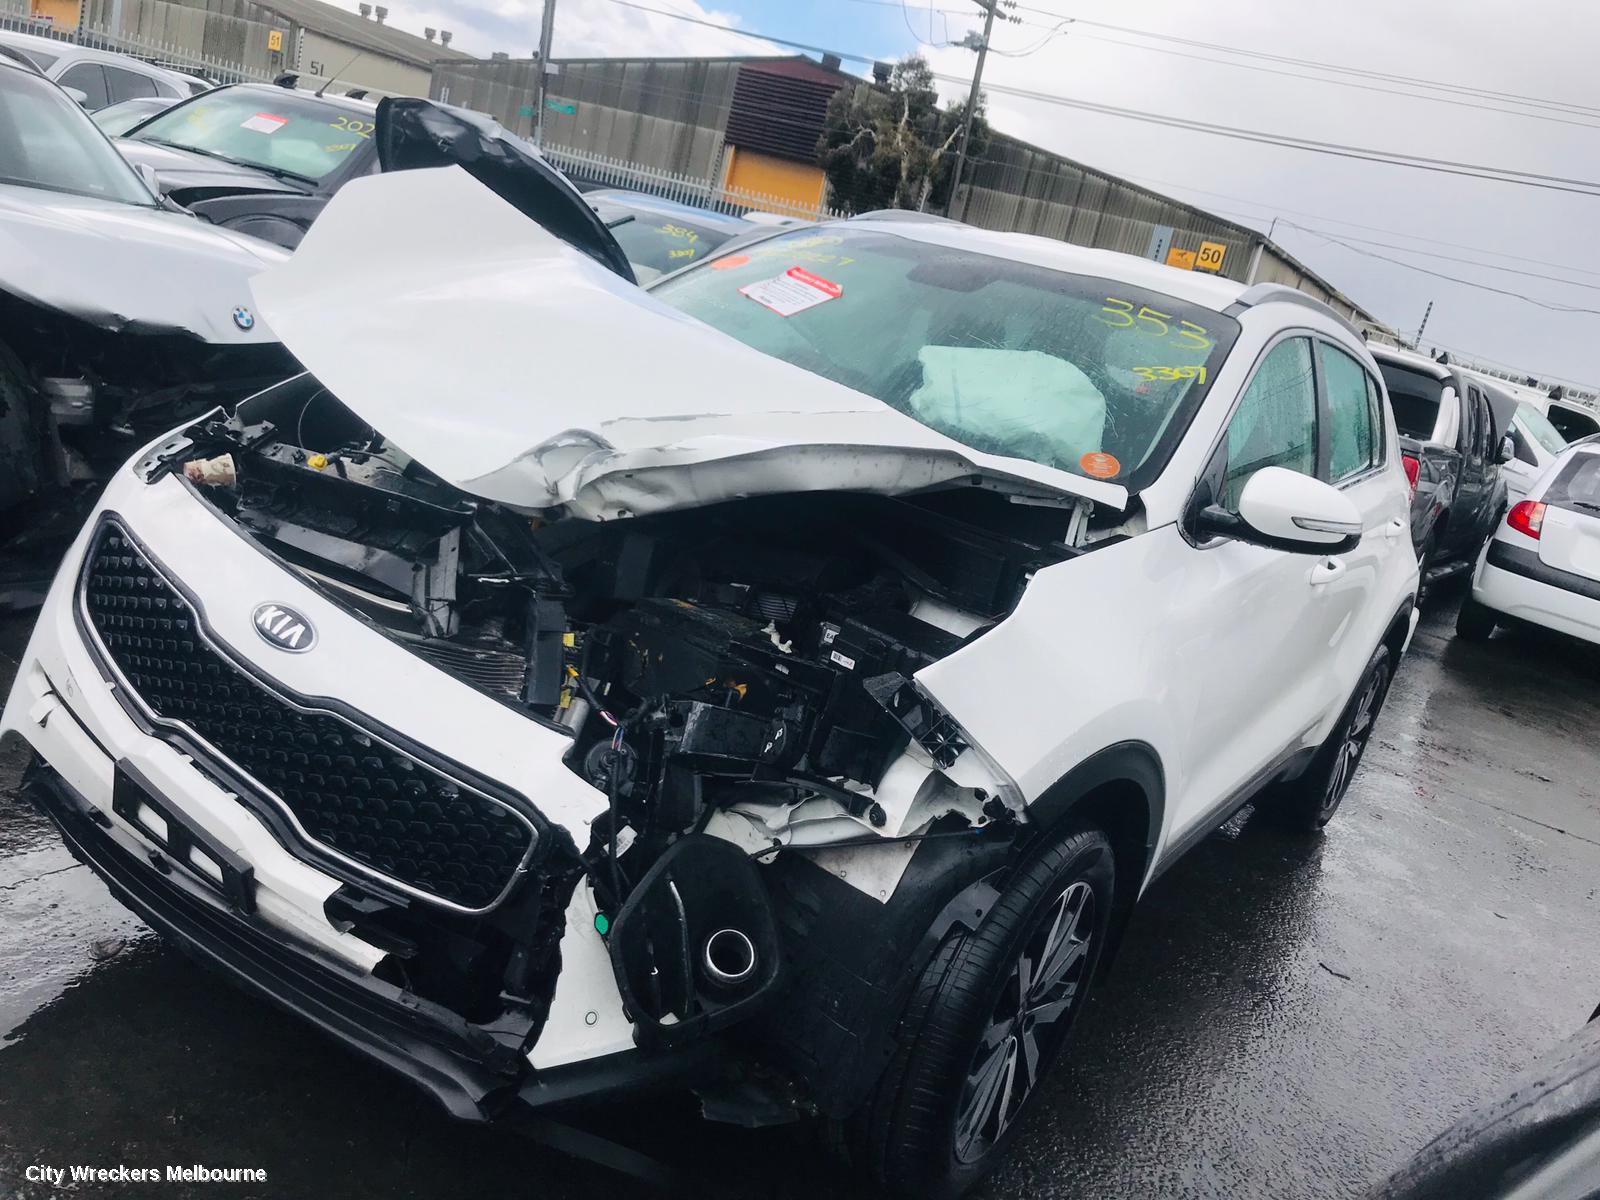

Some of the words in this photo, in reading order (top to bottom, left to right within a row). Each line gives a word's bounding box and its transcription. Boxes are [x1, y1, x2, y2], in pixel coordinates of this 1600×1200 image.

[271, 35, 280, 48] 51
[310, 61, 324, 77] 51
[1200, 247, 1221, 264] 50
[1094, 297, 1210, 349] 353
[256, 605, 306, 648] KIA
